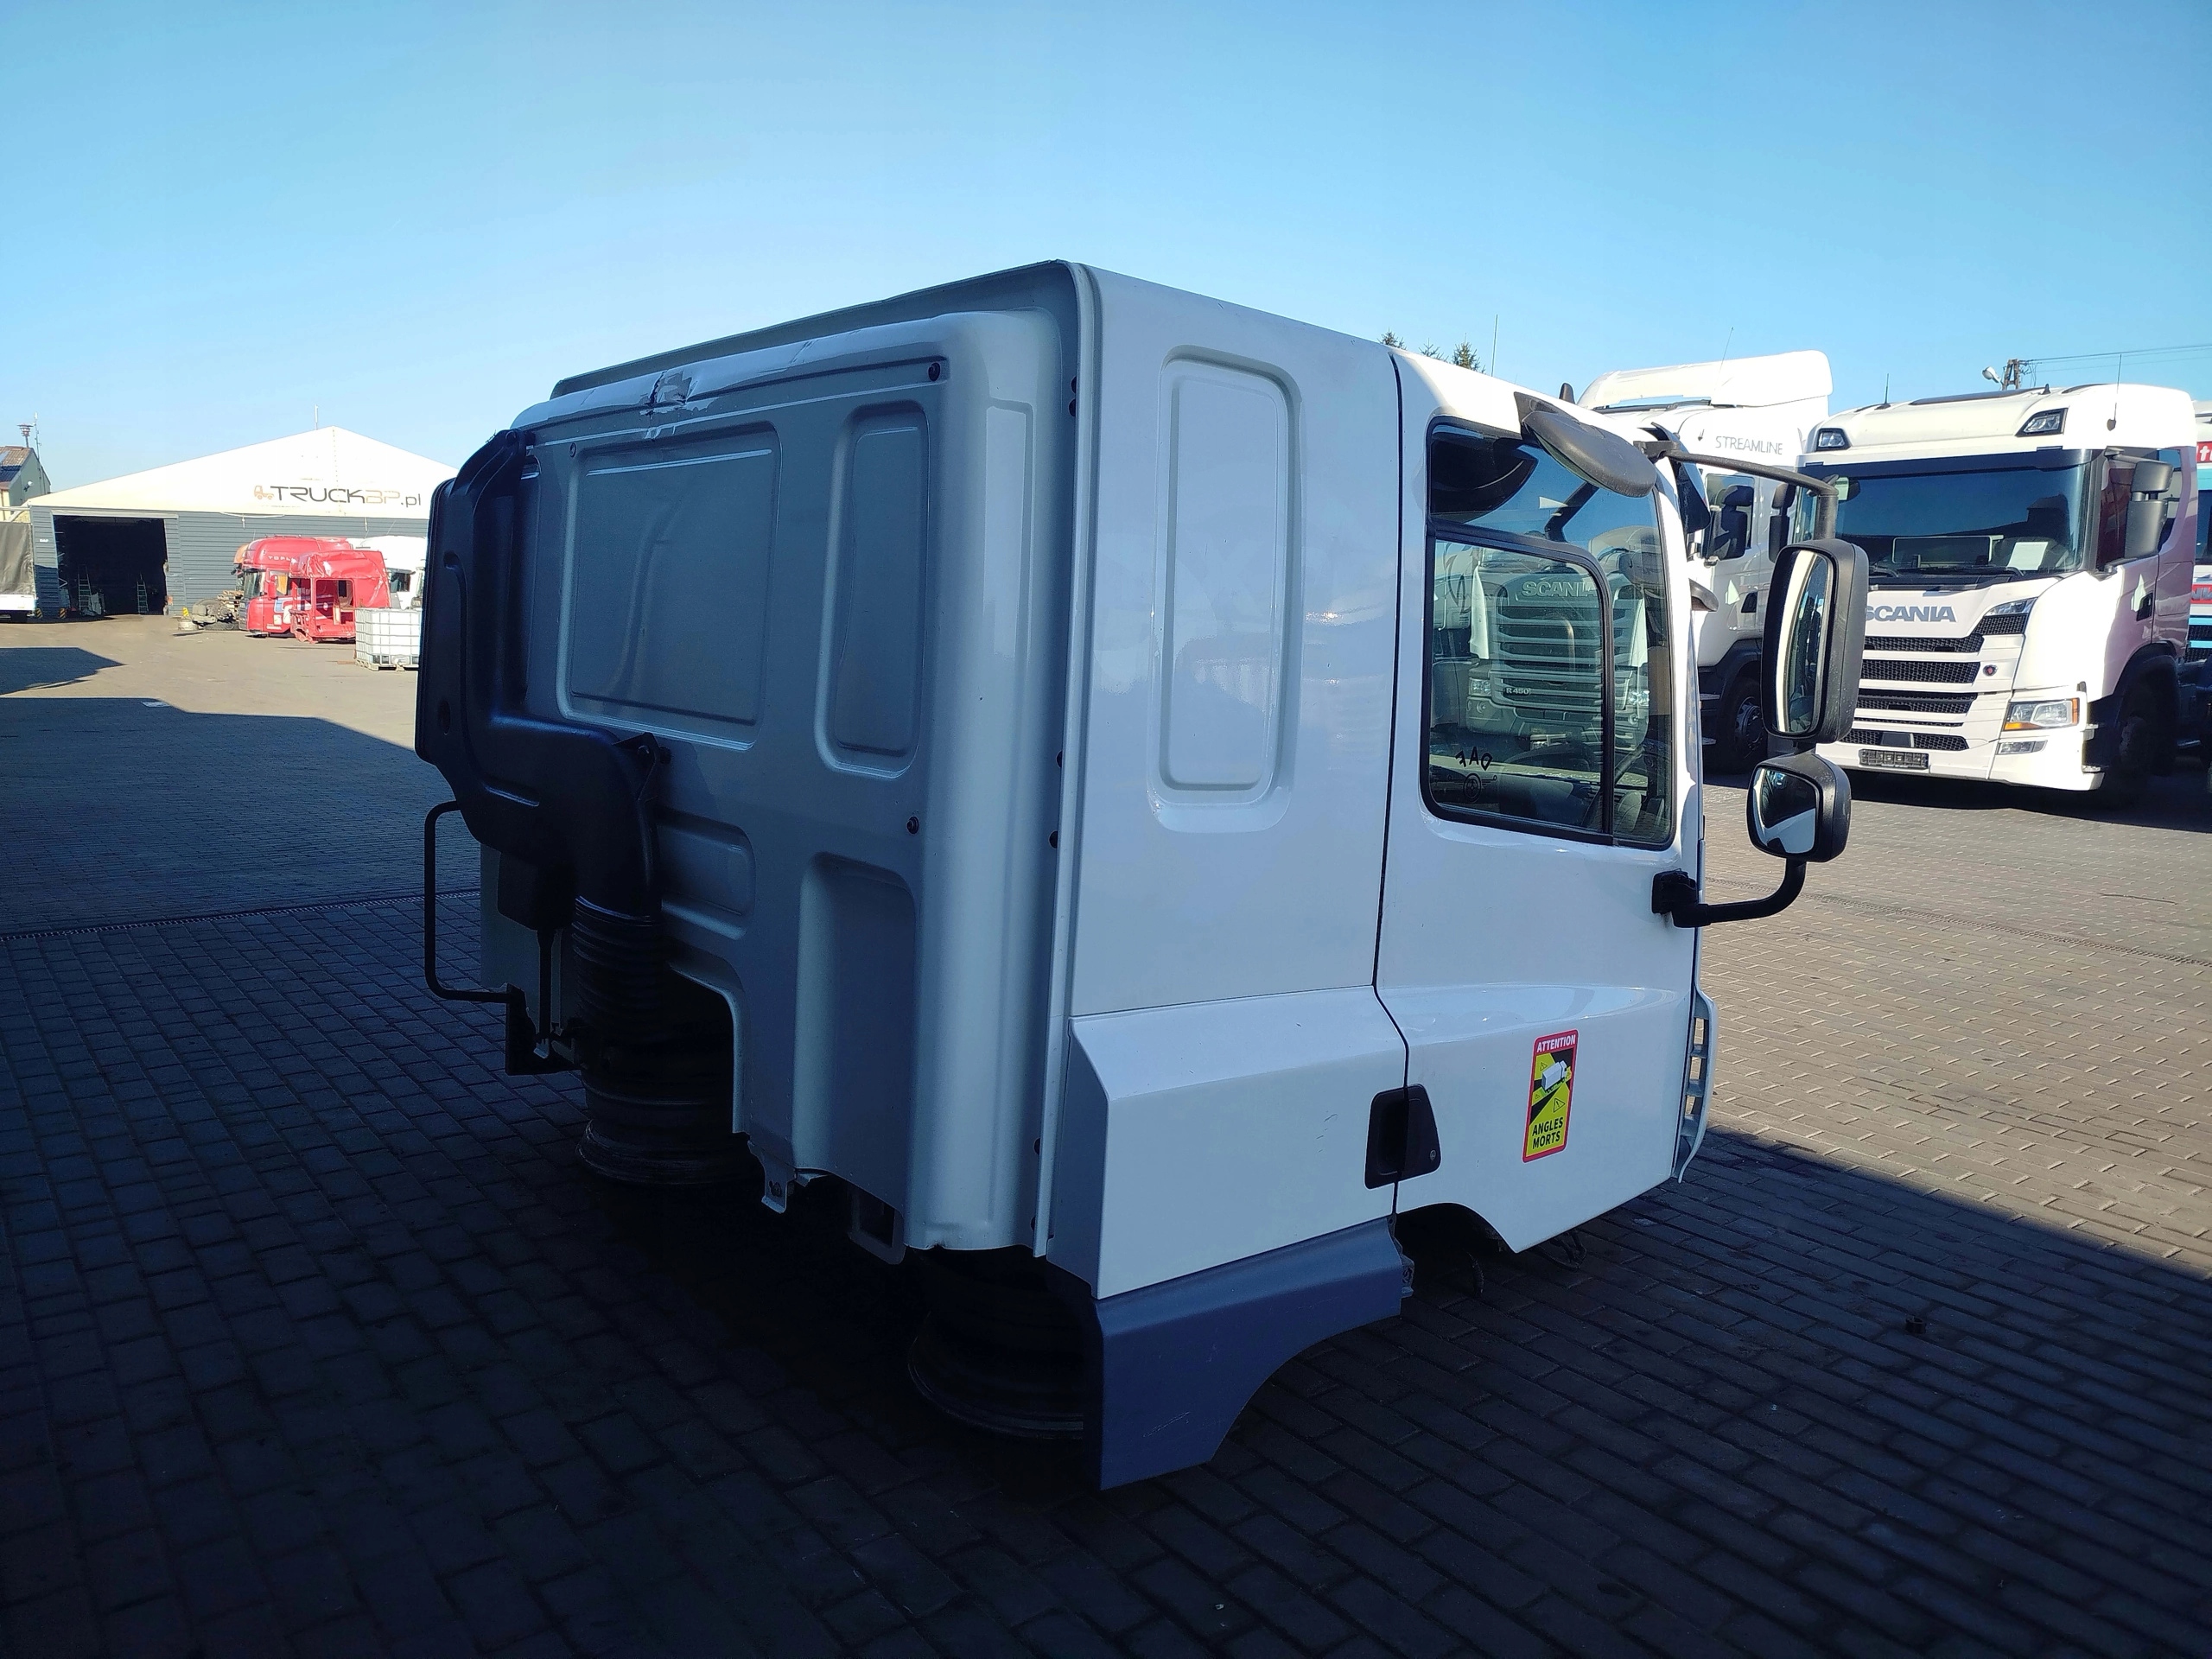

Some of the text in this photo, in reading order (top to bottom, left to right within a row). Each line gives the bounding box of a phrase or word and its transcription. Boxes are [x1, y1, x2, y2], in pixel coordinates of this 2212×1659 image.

[1715, 435, 1783, 455] STREAMLINE
[1522, 581, 1598, 597] SCANIA
[1536, 1034, 1576, 1053] ATTENTION
[1532, 1117, 1563, 1136] ANGLES
[1532, 1131, 1560, 1149] MORTS
